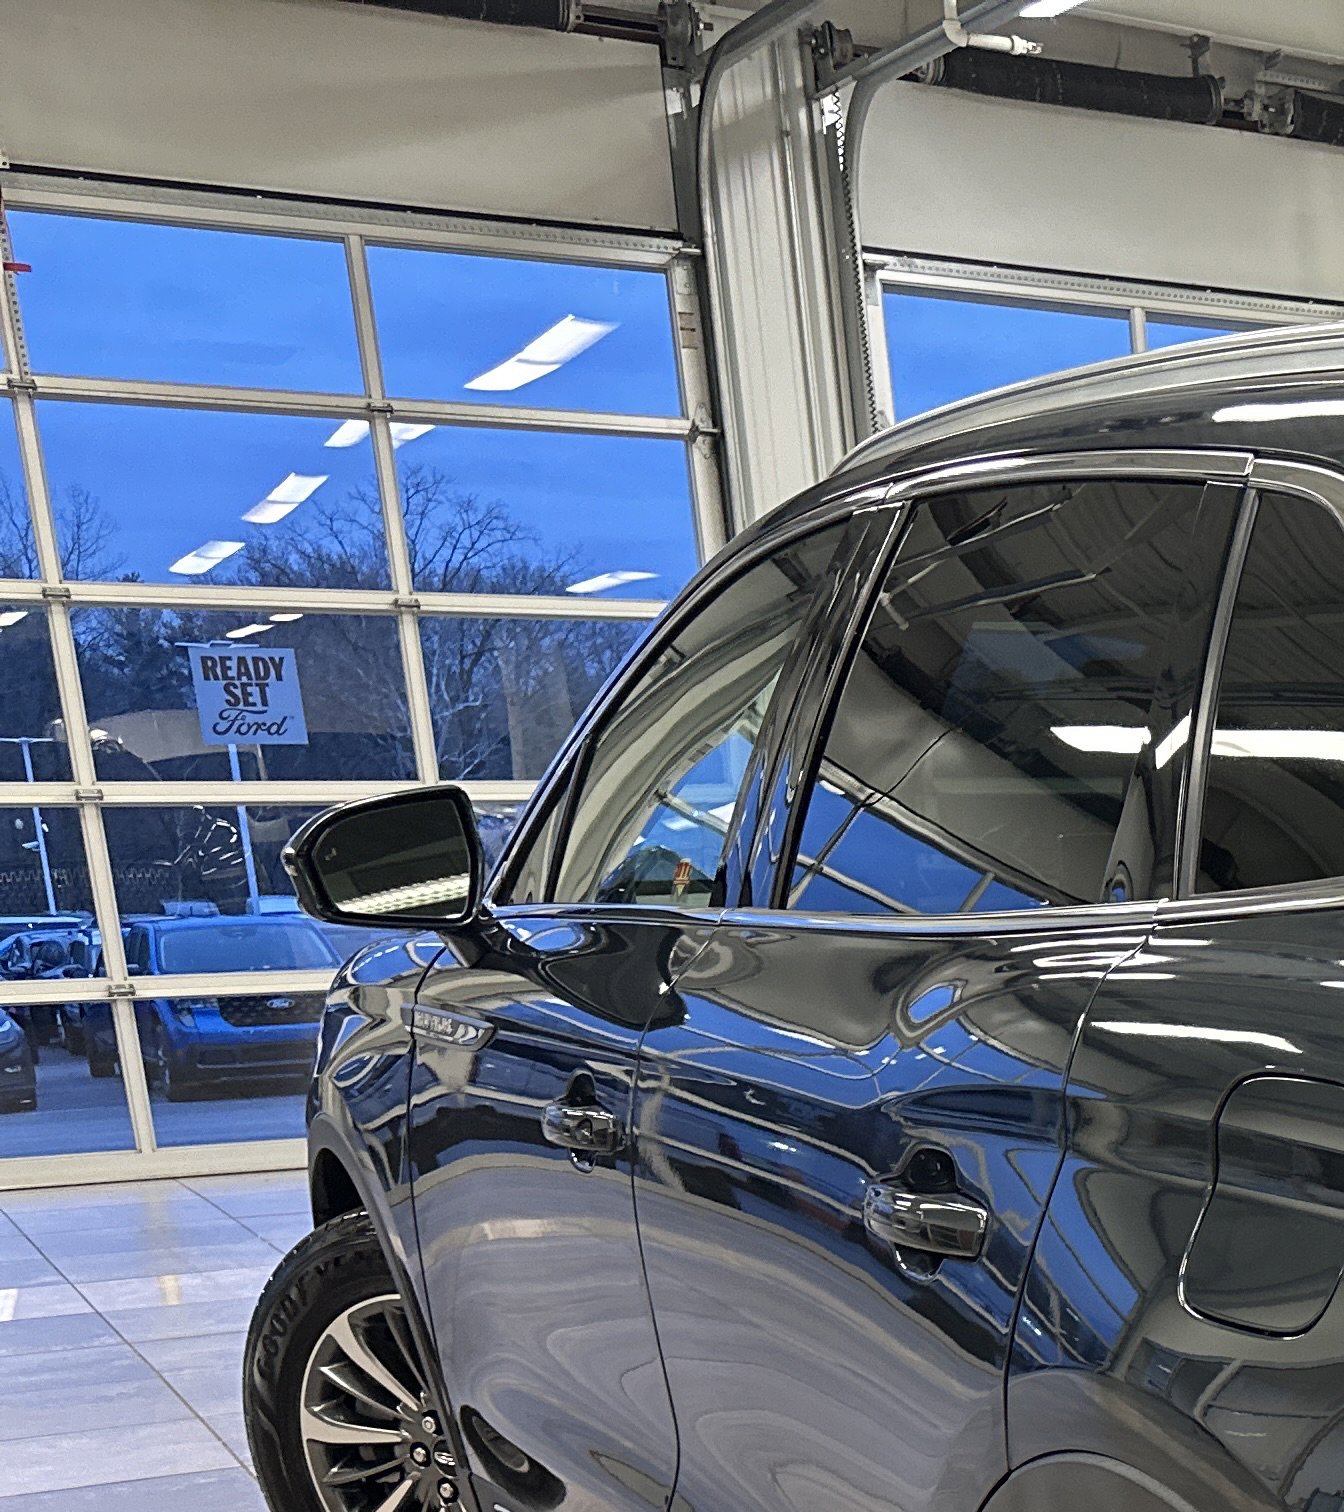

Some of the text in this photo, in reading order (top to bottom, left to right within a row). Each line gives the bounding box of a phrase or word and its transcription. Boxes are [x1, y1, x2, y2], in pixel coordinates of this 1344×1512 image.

[200, 655, 285, 682] READY
[223, 682, 269, 707] SET
[212, 707, 288, 736] Ford
